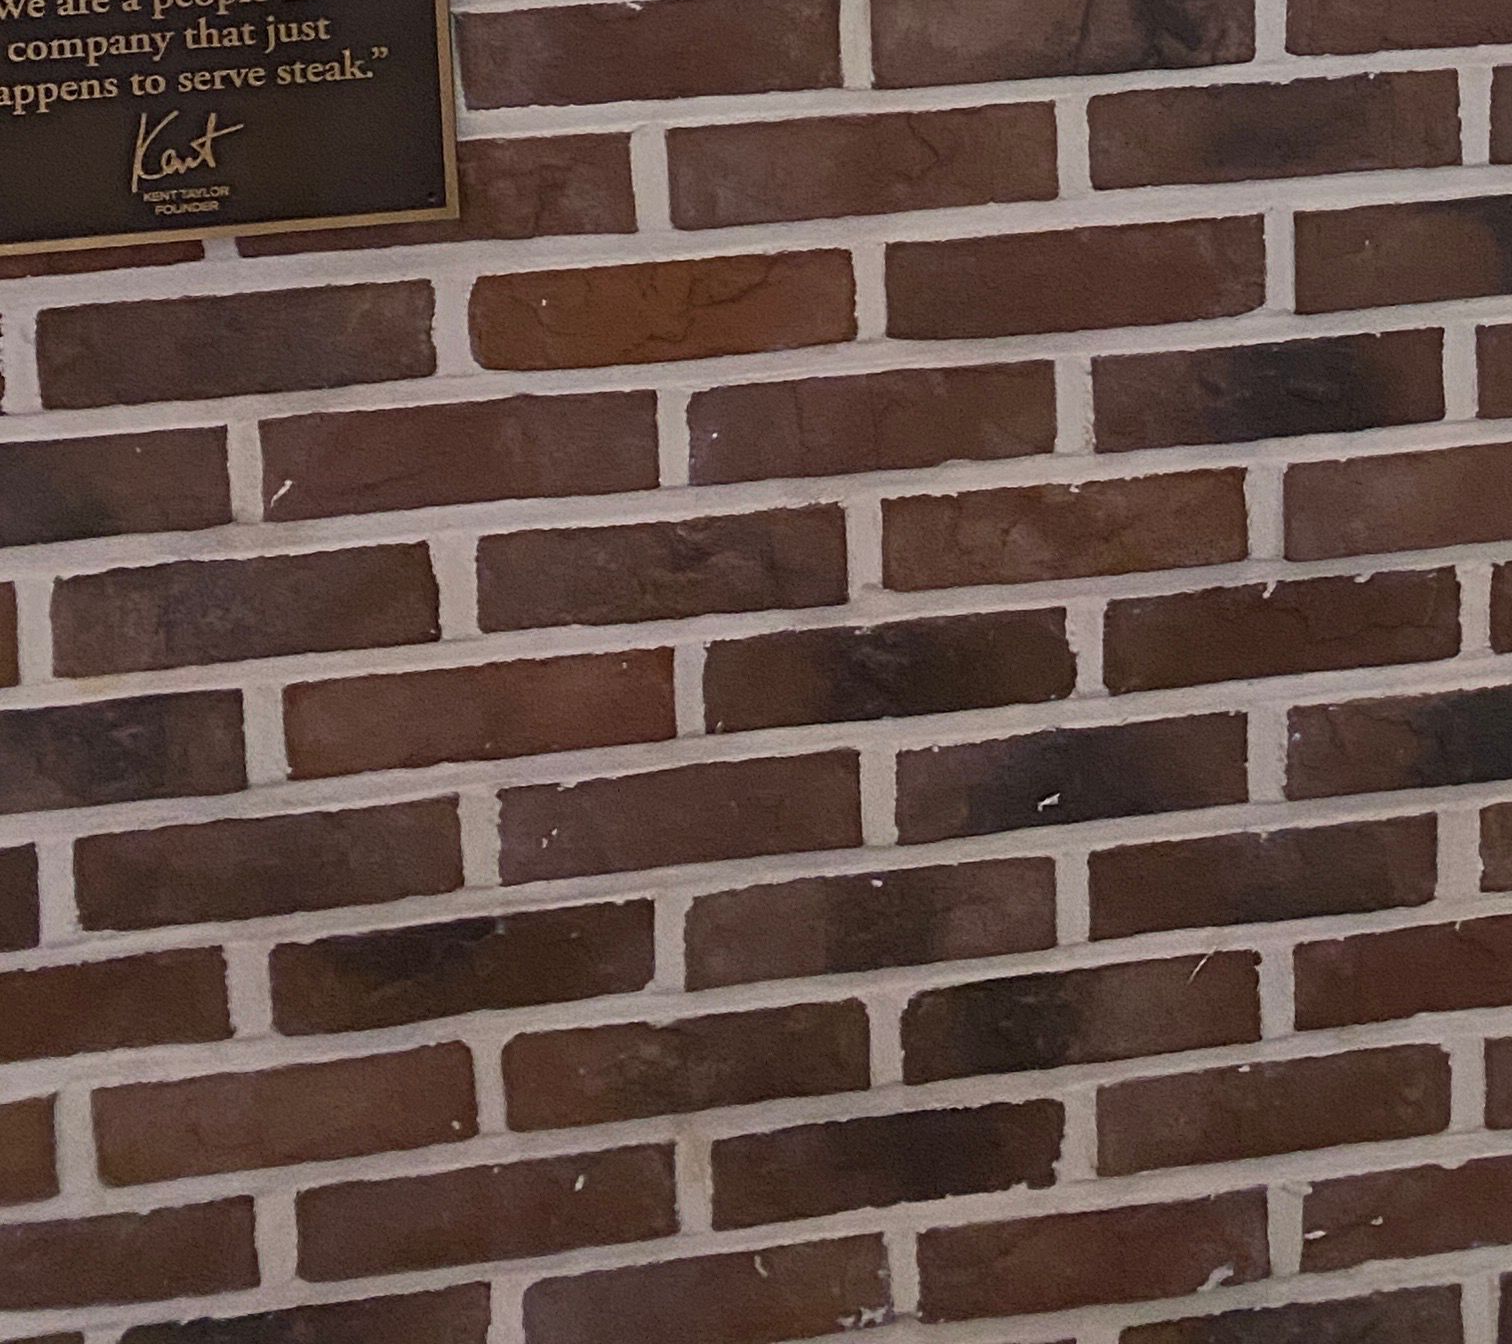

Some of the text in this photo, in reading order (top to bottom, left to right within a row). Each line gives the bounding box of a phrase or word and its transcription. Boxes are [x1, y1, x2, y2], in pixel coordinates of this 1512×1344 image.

[8, 14, 332, 67] company that just
[0, 77, 119, 115] appens
[130, 73, 167, 97] to
[177, 66, 267, 93] serve
[143, 185, 230, 202] KENT TAYLOR
[154, 200, 219, 215] FOUNDER
